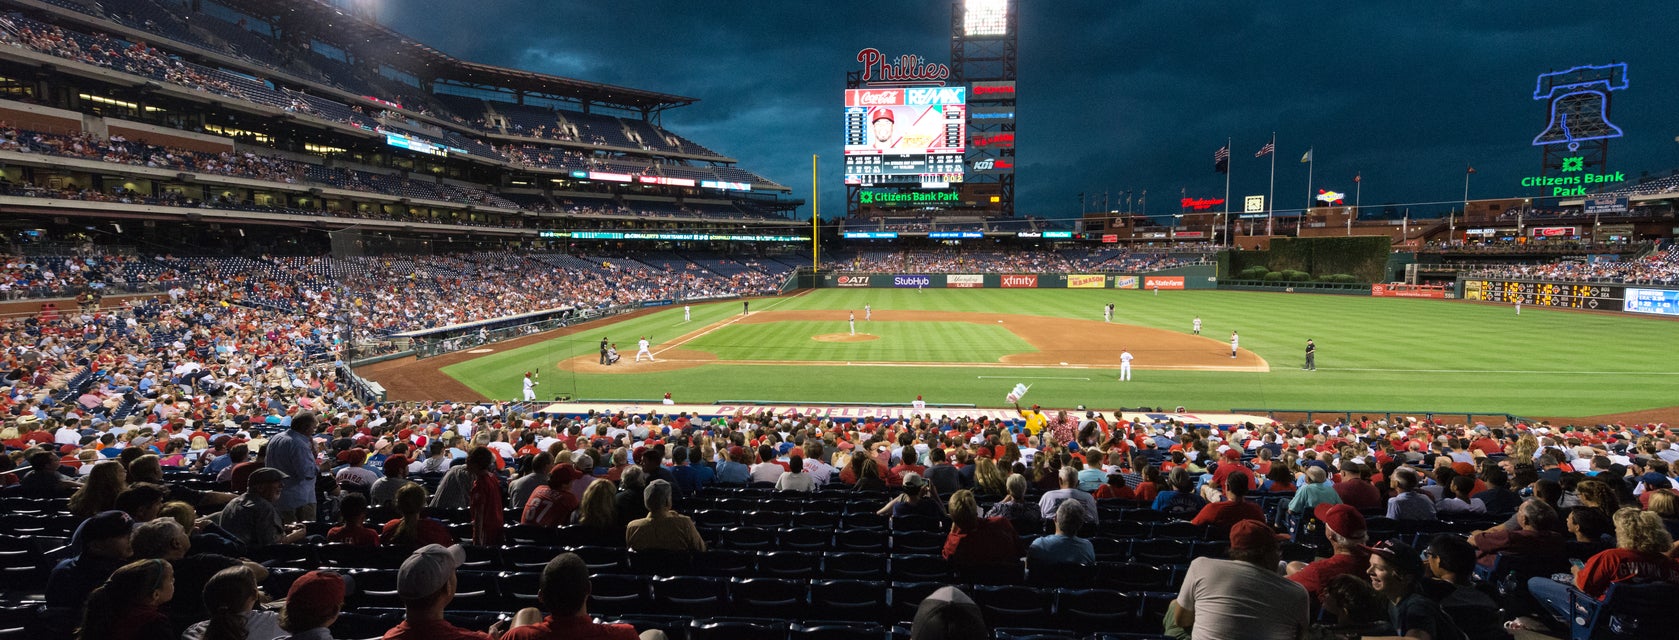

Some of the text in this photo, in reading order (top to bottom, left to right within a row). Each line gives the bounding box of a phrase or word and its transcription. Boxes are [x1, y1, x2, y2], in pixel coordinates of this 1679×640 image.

[857, 47, 950, 81] Phillies
[1521, 171, 1624, 186] Citizens Bank
[1553, 185, 1587, 196] Park
[875, 192, 959, 201] Citizens Bank Park
[894, 277, 929, 285] StubHub
[1003, 276, 1035, 287] xfinity
[1620, 562, 1662, 578] GWYNN
